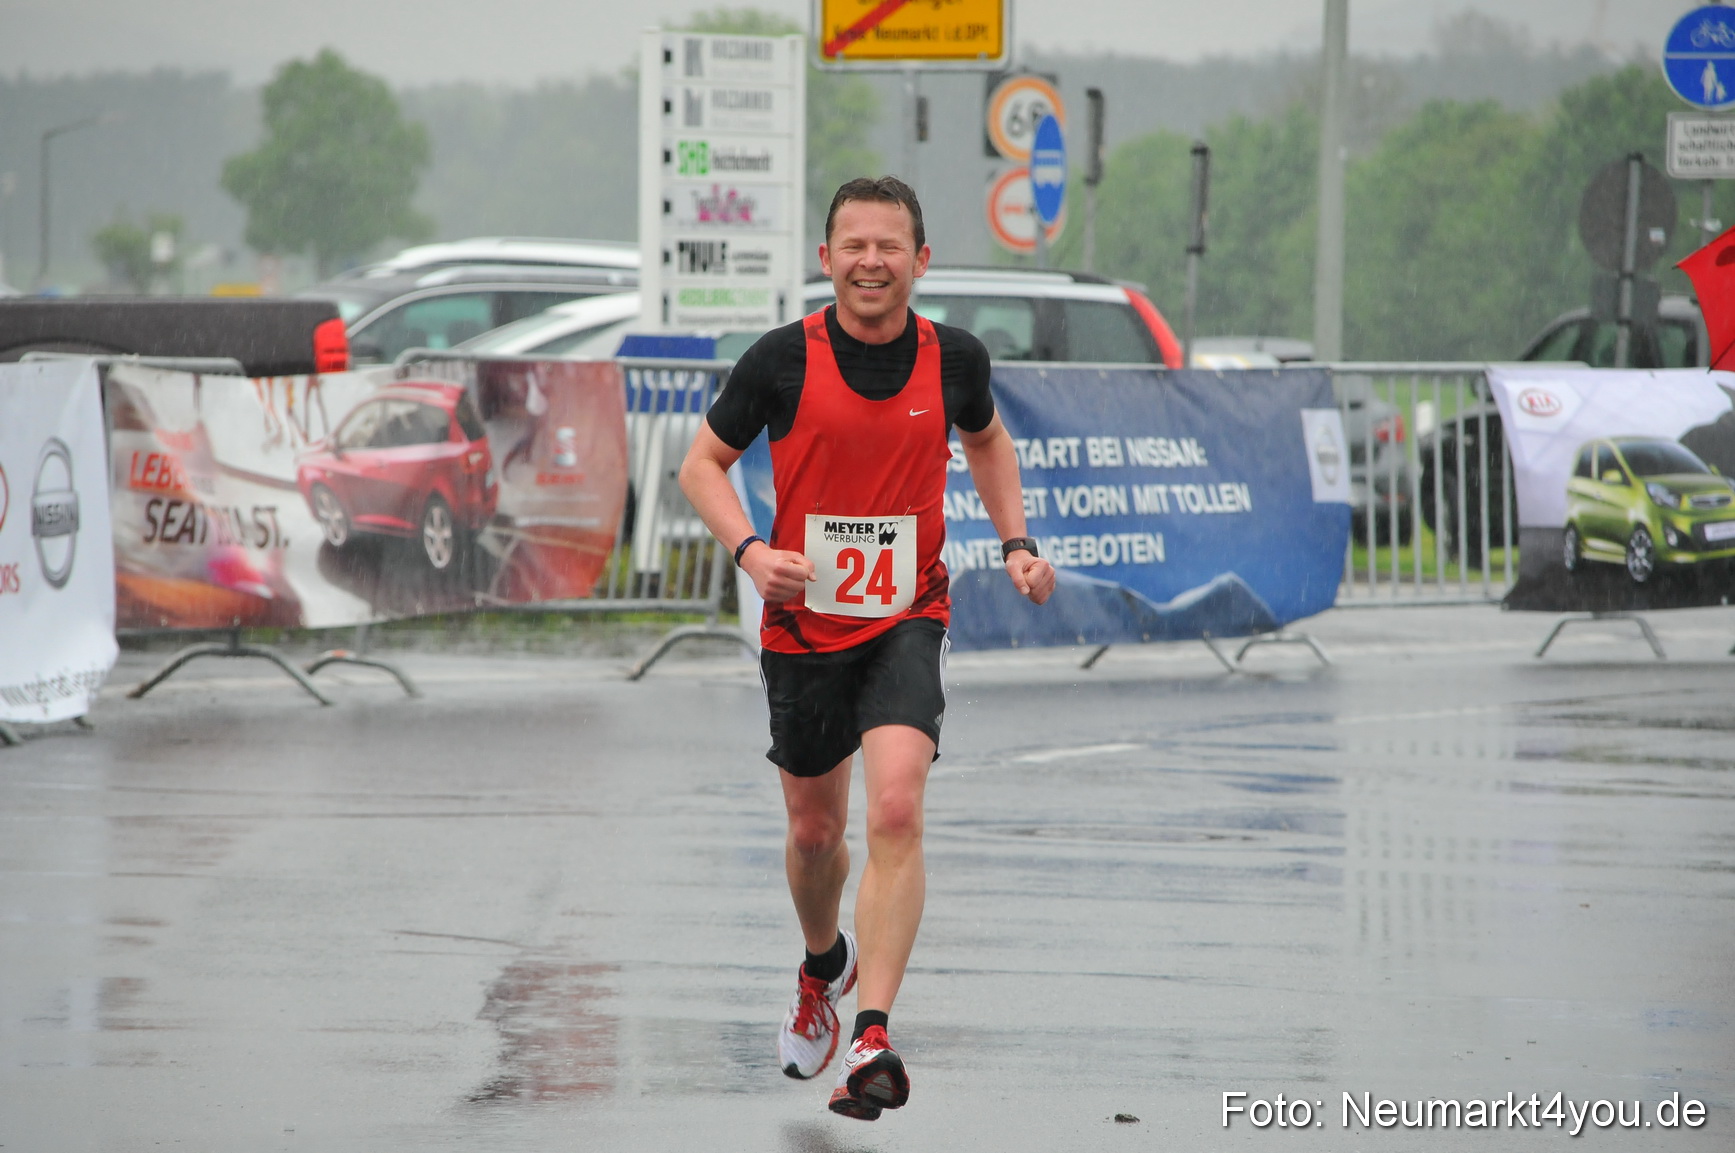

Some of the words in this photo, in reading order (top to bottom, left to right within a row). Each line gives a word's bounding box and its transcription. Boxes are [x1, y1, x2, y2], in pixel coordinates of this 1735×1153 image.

[874, 25, 939, 41] Neumarkt
[1086, 435, 1124, 467] BEI
[1125, 436, 1208, 468] NISSAN:
[943, 489, 993, 522] ANZ
[1021, 486, 1048, 518] EIT
[1052, 484, 1129, 518] VORN
[1131, 483, 1170, 515] MIT
[1169, 481, 1252, 515] TOLLEN
[824, 521, 875, 534] MEYER
[824, 533, 875, 544] WERBUNG
[835, 547, 898, 605] 24
